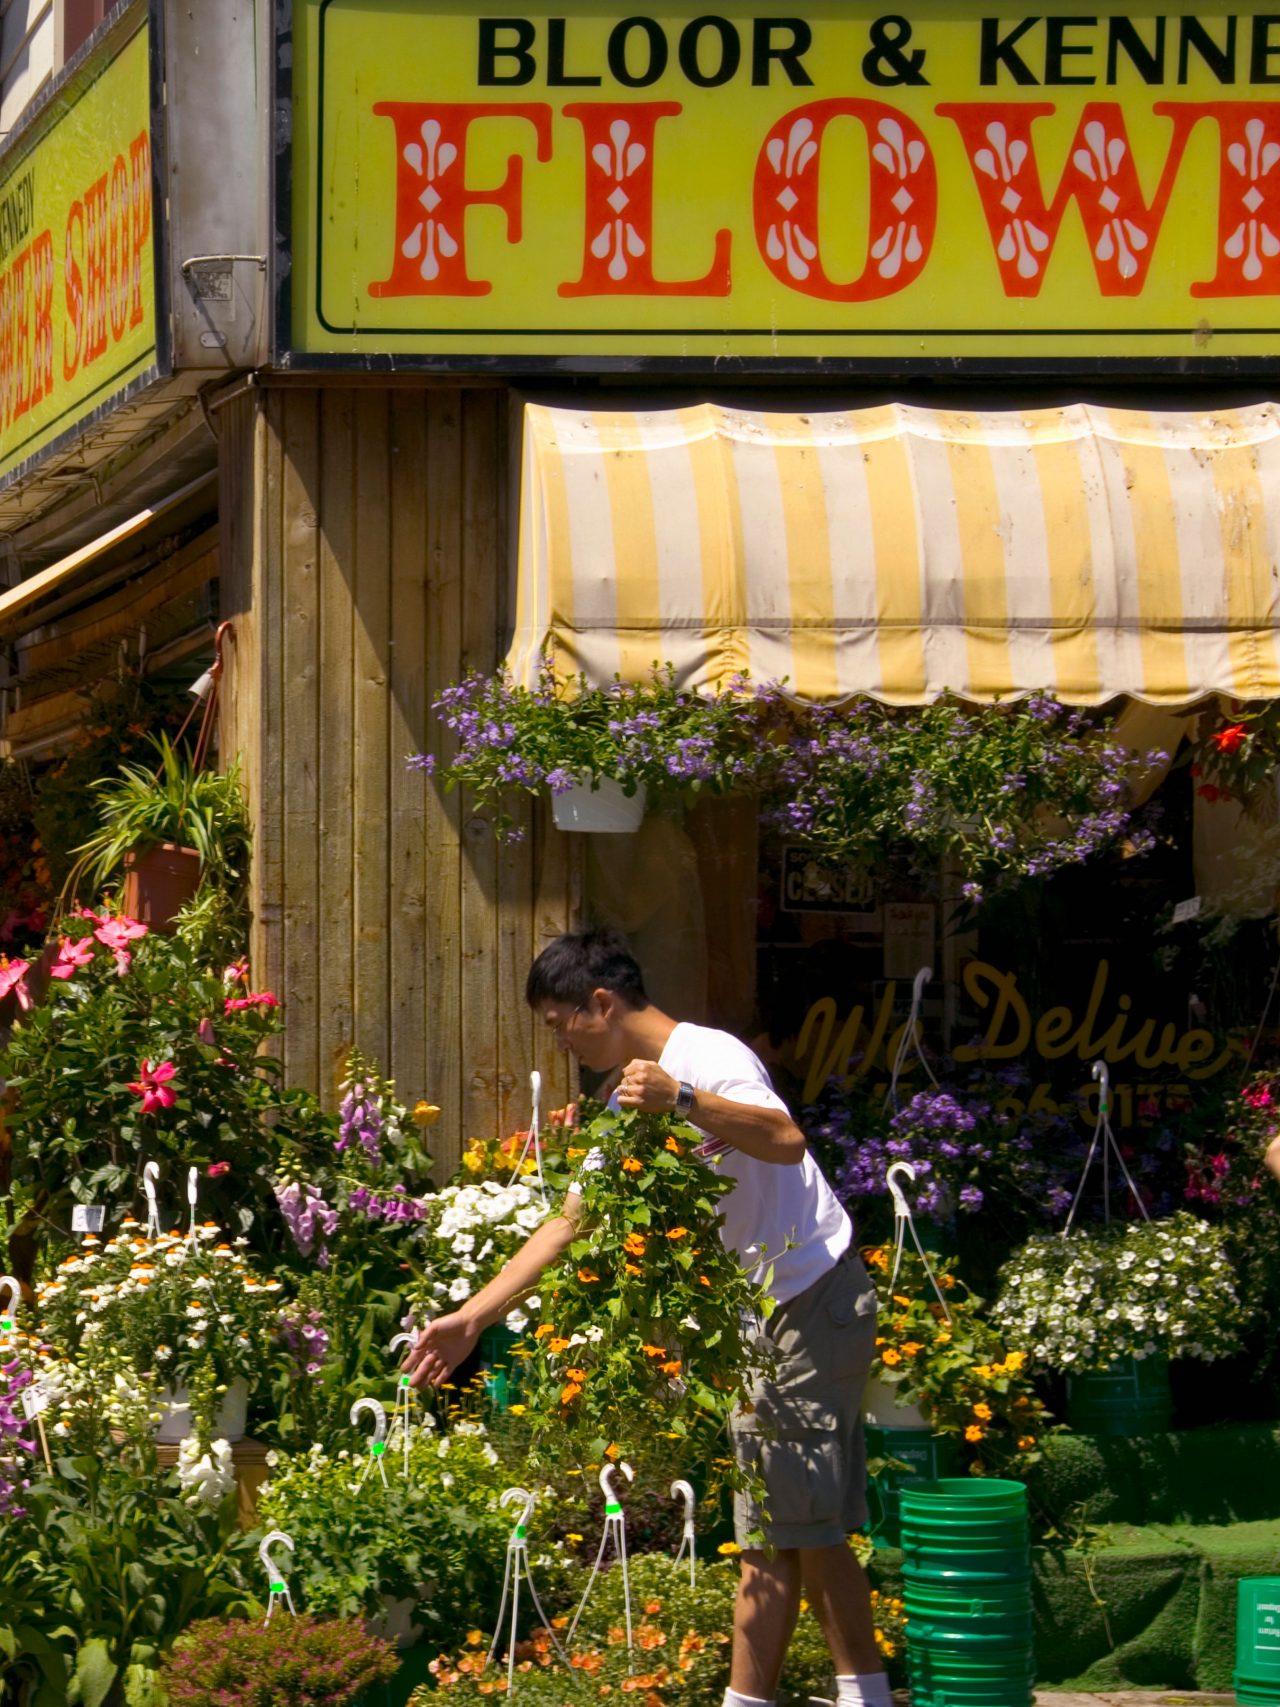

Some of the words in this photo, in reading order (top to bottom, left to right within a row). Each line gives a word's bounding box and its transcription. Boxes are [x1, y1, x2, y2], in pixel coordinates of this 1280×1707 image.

[477, 15, 814, 88] BLOOR
[861, 14, 928, 88] &
[63, 129, 152, 382] SHOP
[786, 870, 874, 905] CLSED
[795, 980, 926, 1100] We
